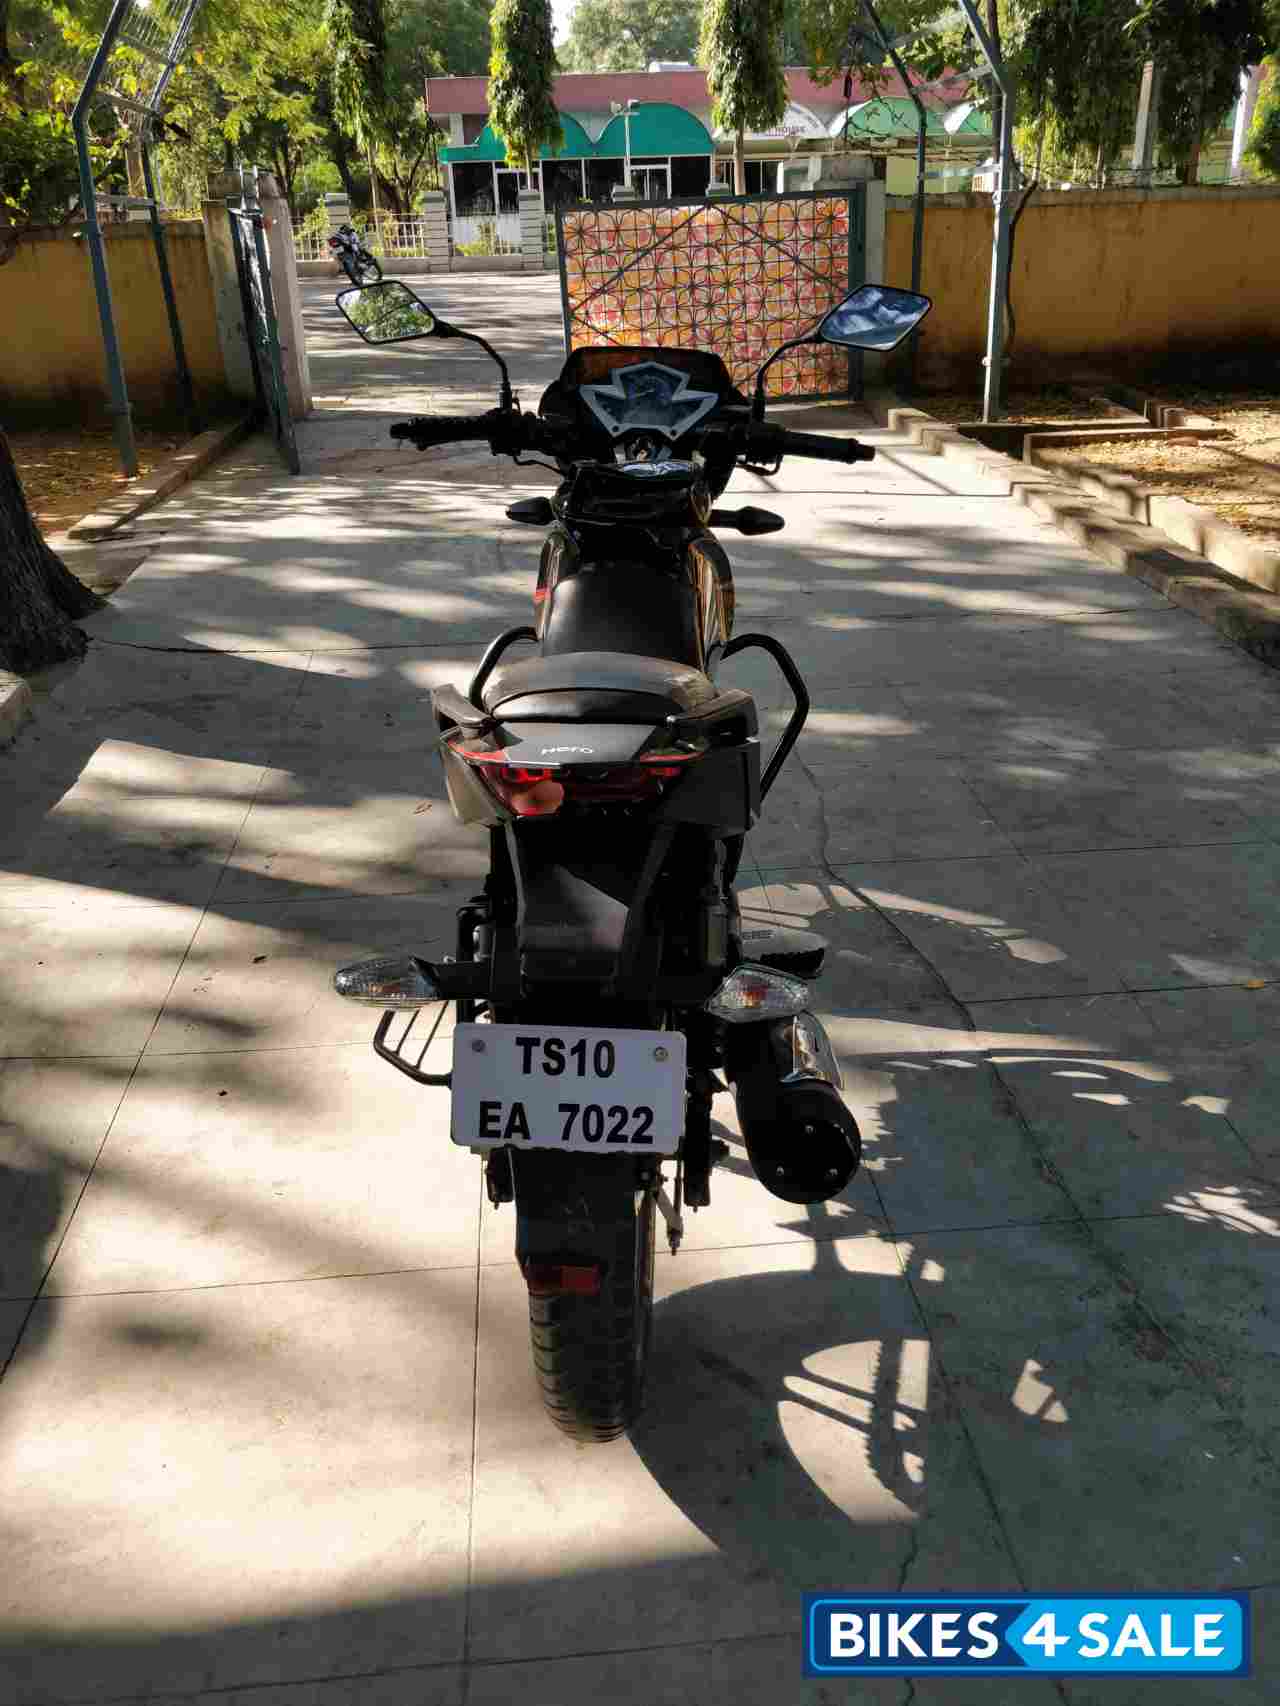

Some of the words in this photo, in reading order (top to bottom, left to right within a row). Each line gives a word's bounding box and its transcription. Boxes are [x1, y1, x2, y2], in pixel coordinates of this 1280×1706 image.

[515, 1036, 616, 1079] TS10
[478, 1100, 531, 1141] EA
[558, 1102, 654, 1145] 7022
